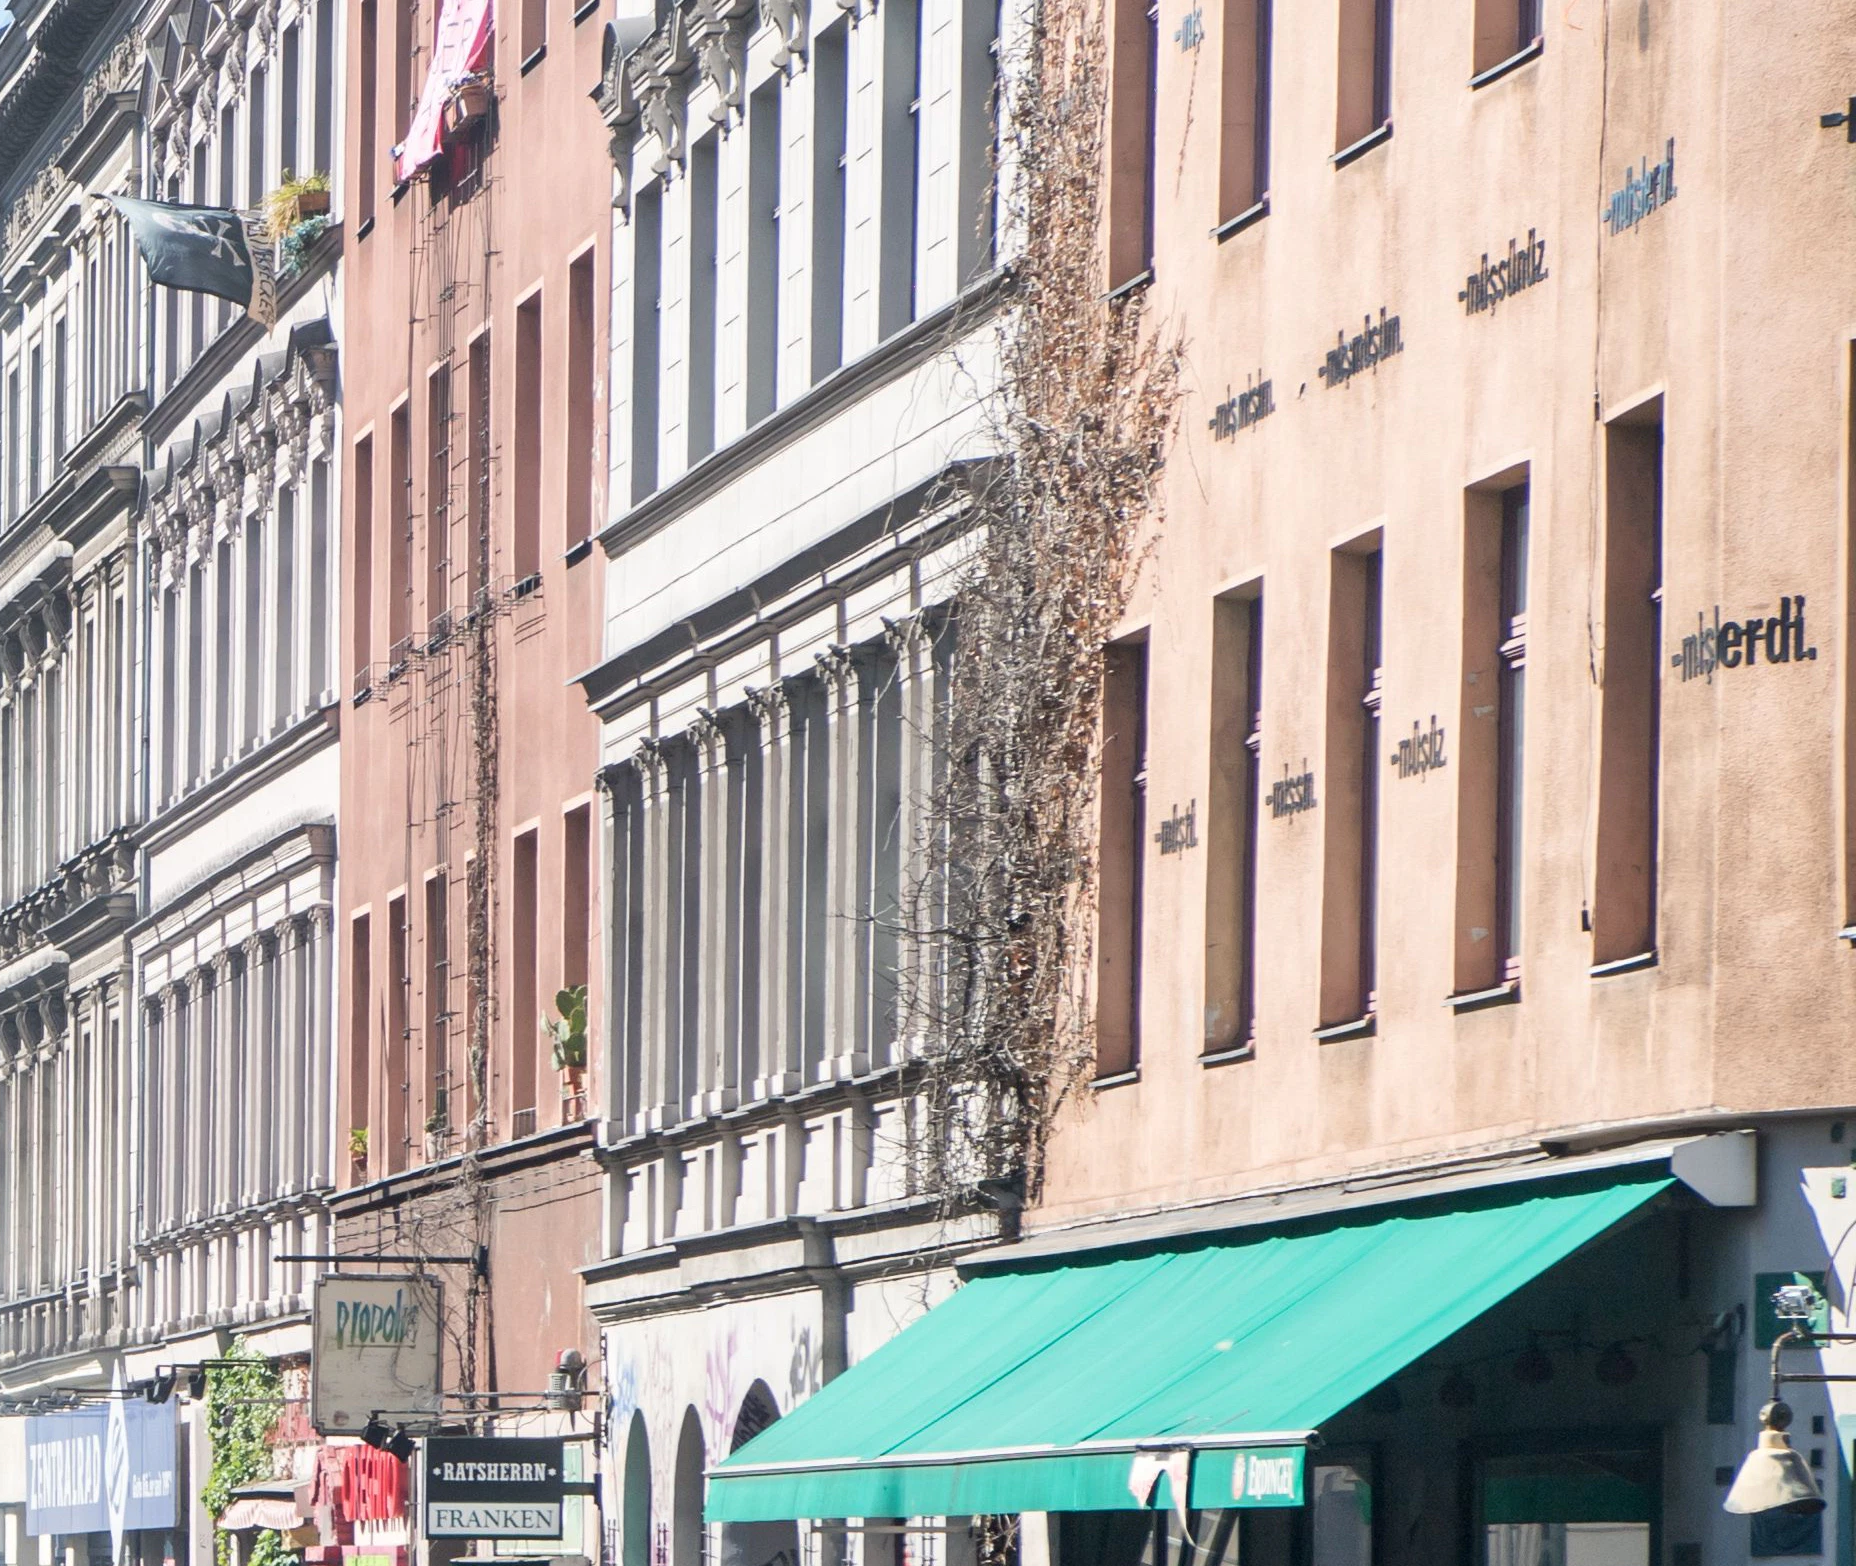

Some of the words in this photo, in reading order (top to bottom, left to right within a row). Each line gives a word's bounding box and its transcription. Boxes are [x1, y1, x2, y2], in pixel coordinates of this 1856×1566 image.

[30, 1434, 101, 1510] ZENTRALRAD
[443, 1462, 546, 1481] RATSHERRN
[436, 1509, 553, 1529] FRANKEN
